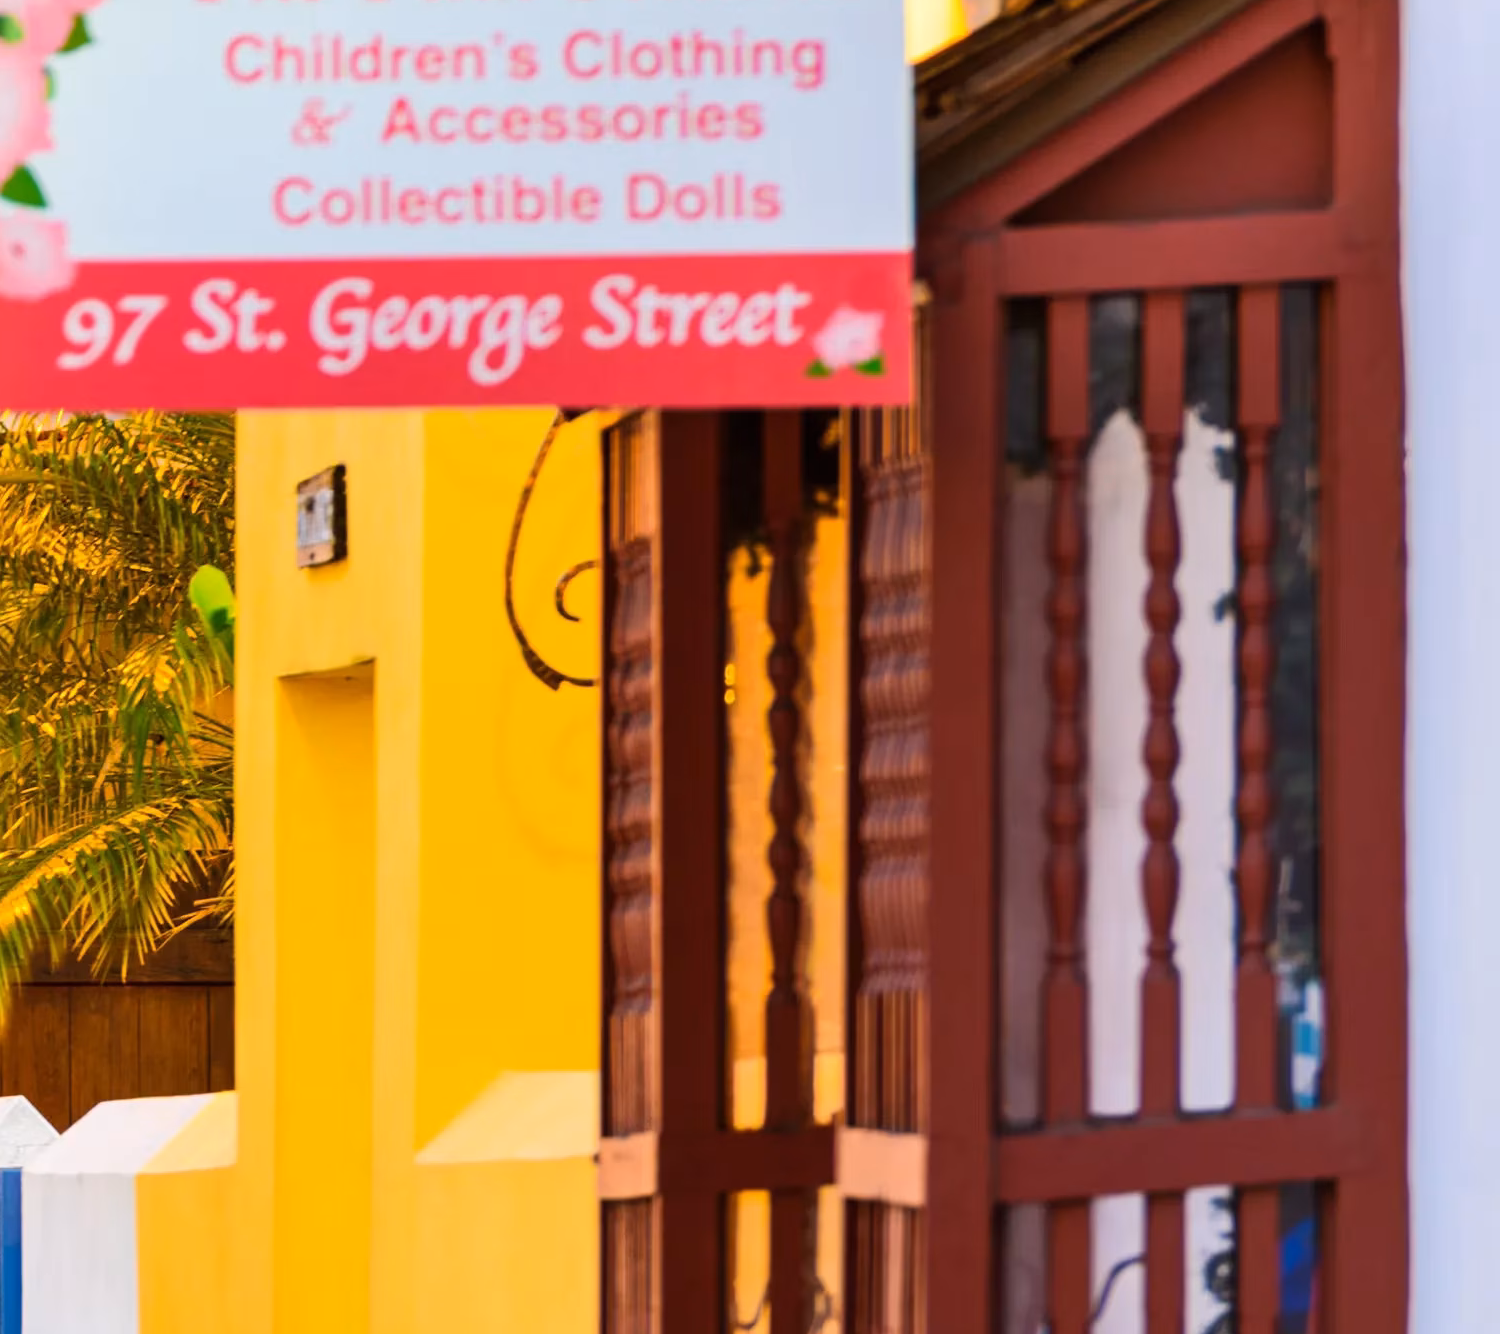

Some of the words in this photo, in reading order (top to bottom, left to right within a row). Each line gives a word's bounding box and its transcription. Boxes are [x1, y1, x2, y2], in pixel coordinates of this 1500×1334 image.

[224, 33, 540, 86] Children's
[563, 31, 828, 91] Clothing
[292, 100, 350, 146] &
[382, 95, 764, 144] Accessories
[273, 174, 600, 227] Collectible
[627, 173, 782, 222] Dolls
[57, 294, 169, 371] 97
[183, 278, 287, 353] St.
[309, 278, 563, 387] George
[581, 273, 811, 351] Street
